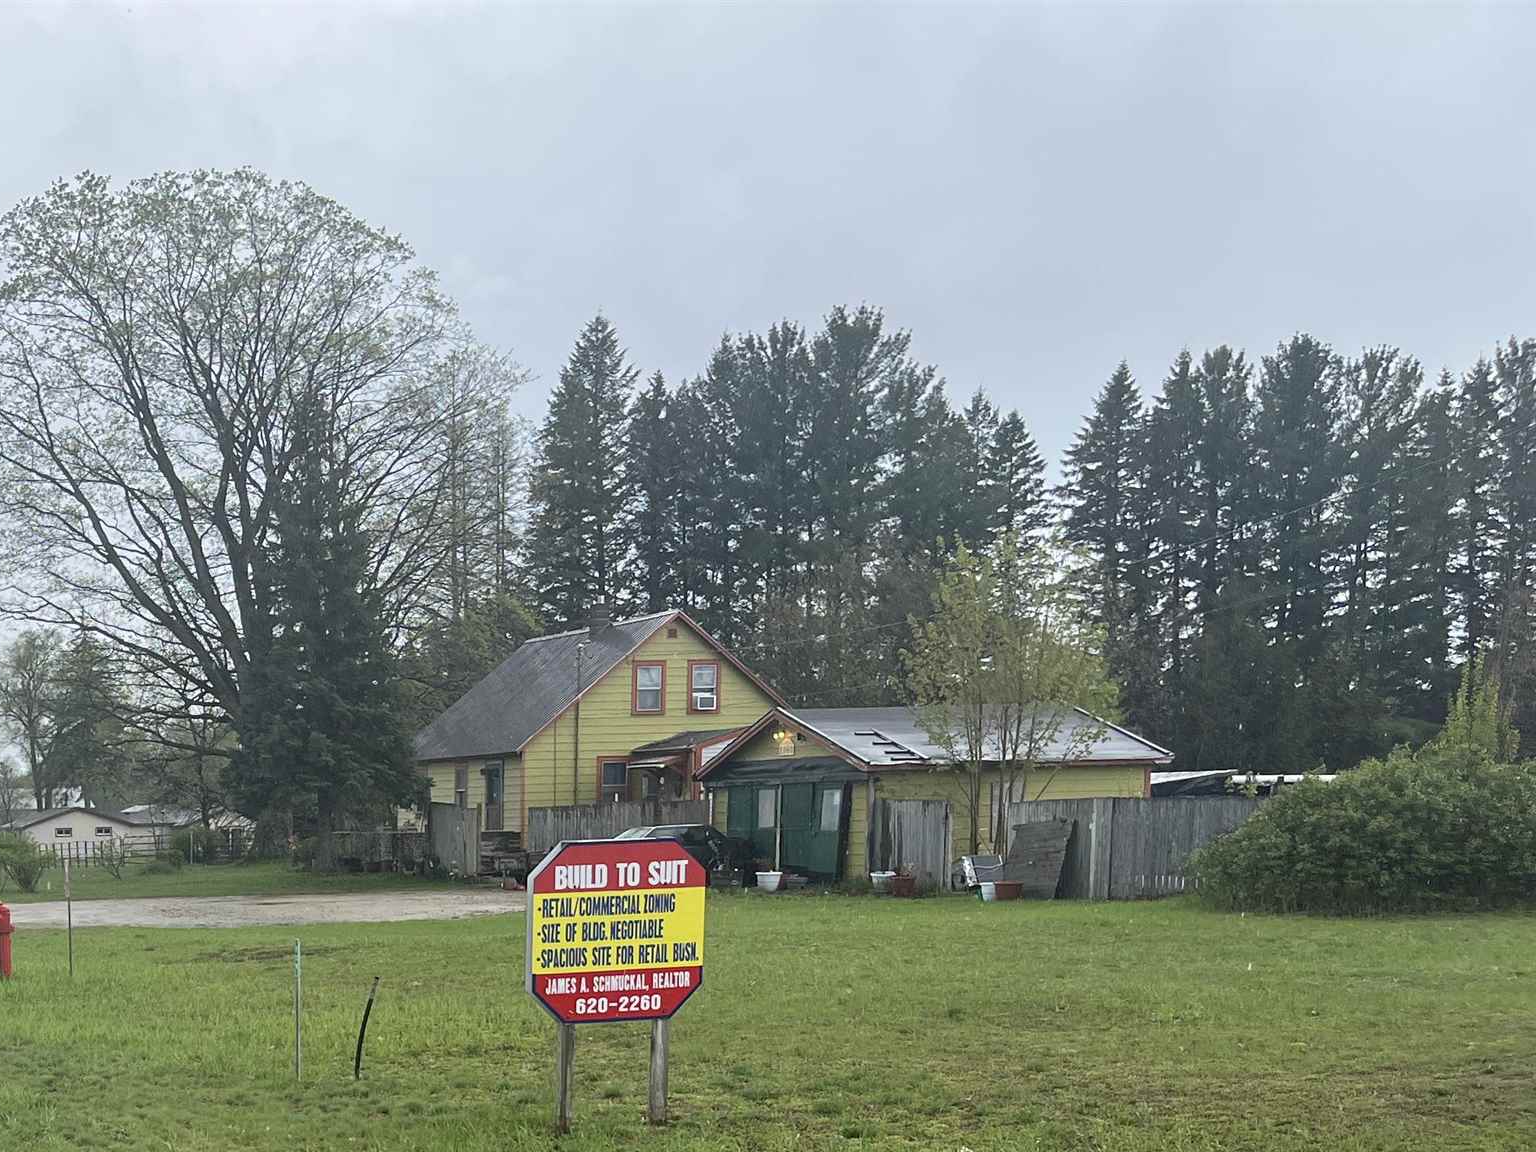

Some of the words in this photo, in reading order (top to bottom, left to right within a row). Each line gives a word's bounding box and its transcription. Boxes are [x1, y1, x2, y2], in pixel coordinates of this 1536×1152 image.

[555, 863, 608, 890] BUILD
[616, 862, 641, 887] TO
[648, 859, 689, 886] SUIT
[643, 893, 676, 914] ZONING
[565, 922, 577, 942] OF
[582, 921, 608, 941] BLDG.
[610, 919, 664, 940] NEGOTIABLE
[592, 946, 612, 966] SITE
[616, 945, 634, 965] FOR
[639, 943, 669, 964] RETAIL
[545, 976, 576, 995] JAMES
[580, 976, 589, 993] A.
[593, 973, 649, 992] SCHMUCKAL,
[652, 971, 690, 989] REALTOR
[575, 994, 661, 1014] 620-2260
